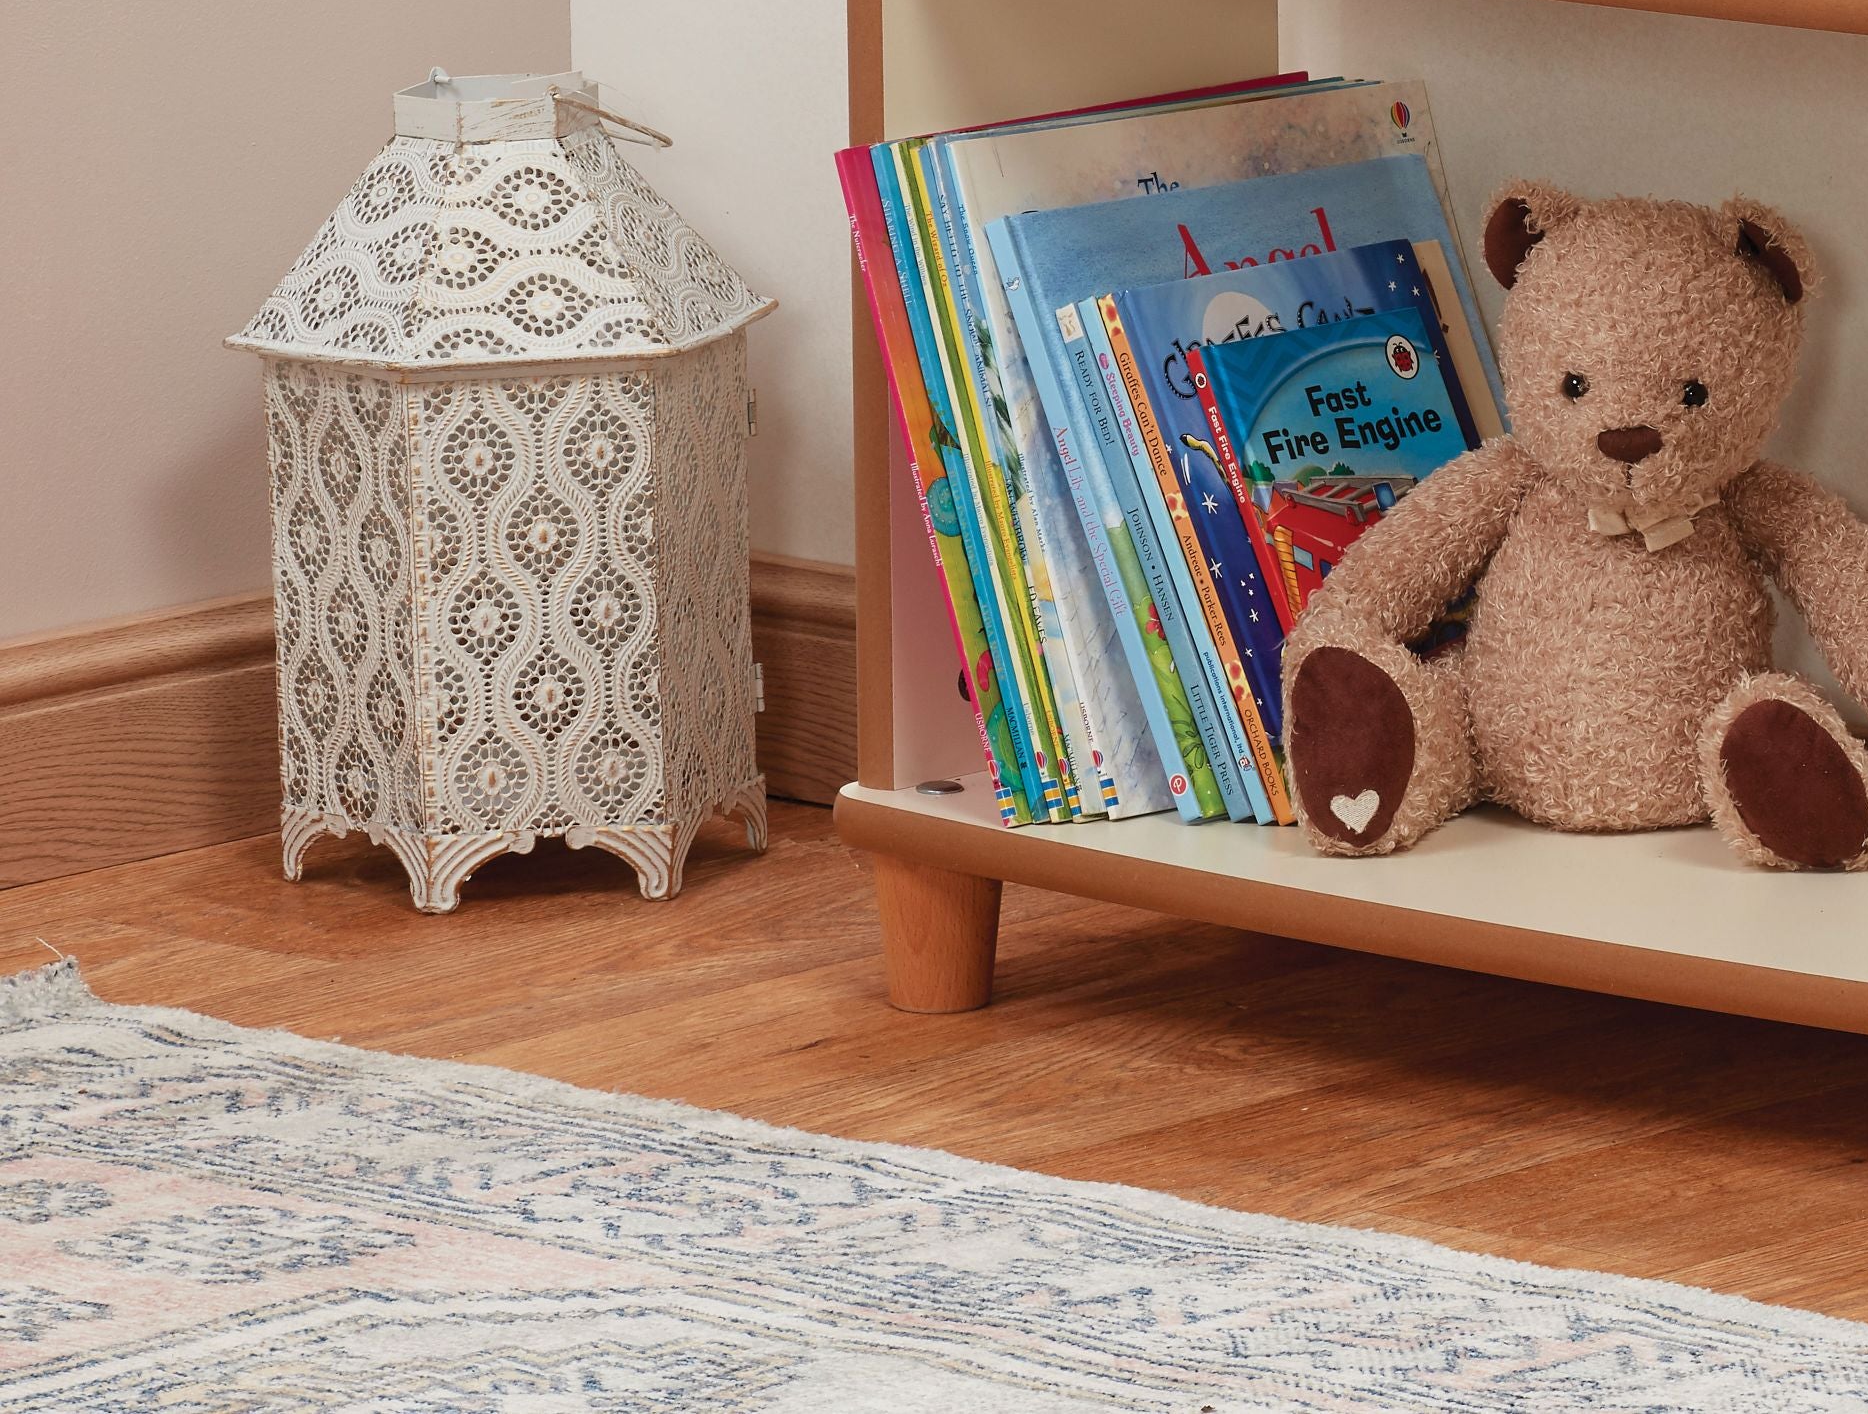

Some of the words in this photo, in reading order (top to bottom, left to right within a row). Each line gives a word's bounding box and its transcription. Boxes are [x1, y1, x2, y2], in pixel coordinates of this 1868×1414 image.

[926, 210, 935, 227] The
[849, 213, 857, 228] The
[853, 230, 868, 272] Nutcracker
[930, 229, 942, 260] Wizard
[941, 274, 949, 287] Oz
[1106, 371, 1127, 417] Sleeping
[1120, 417, 1143, 456] Beauty
[1119, 352, 1143, 400] Giraffes
[1137, 402, 1155, 435] Can't
[1149, 437, 1170, 476] Dance
[1305, 381, 1372, 417] Fast
[1053, 424, 1077, 465] Angel
[1208, 406, 1221, 434] Fast
[1218, 434, 1231, 461] Fire
[1229, 463, 1246, 504] Engine
[1262, 428, 1330, 465] Fire
[1334, 406, 1442, 451] Engine
[910, 461, 926, 500] Illustrated
[1066, 466, 1086, 492] Lily
[921, 501, 928, 511] by
[924, 512, 935, 533] Anna
[1078, 494, 1094, 518] and
[1085, 518, 1103, 542] the
[1090, 541, 1120, 587] Special
[1127, 507, 1155, 561] JOHNSON
[1152, 574, 1176, 621] HANSEN
[1183, 535, 1202, 577] Andreae
[1202, 586, 1227, 647] Parker-Rees
[1203, 651, 1223, 694] publications
[975, 712, 992, 753] USBORNE
[1006, 707, 1025, 758] MACMILLAN
[1190, 684, 1207, 723] LITTLE
[1205, 725, 1221, 760] TIGER
[1218, 762, 1234, 796] PRESS
[1244, 708, 1267, 760] ORCHARD
[1262, 761, 1279, 796] BOOKS
